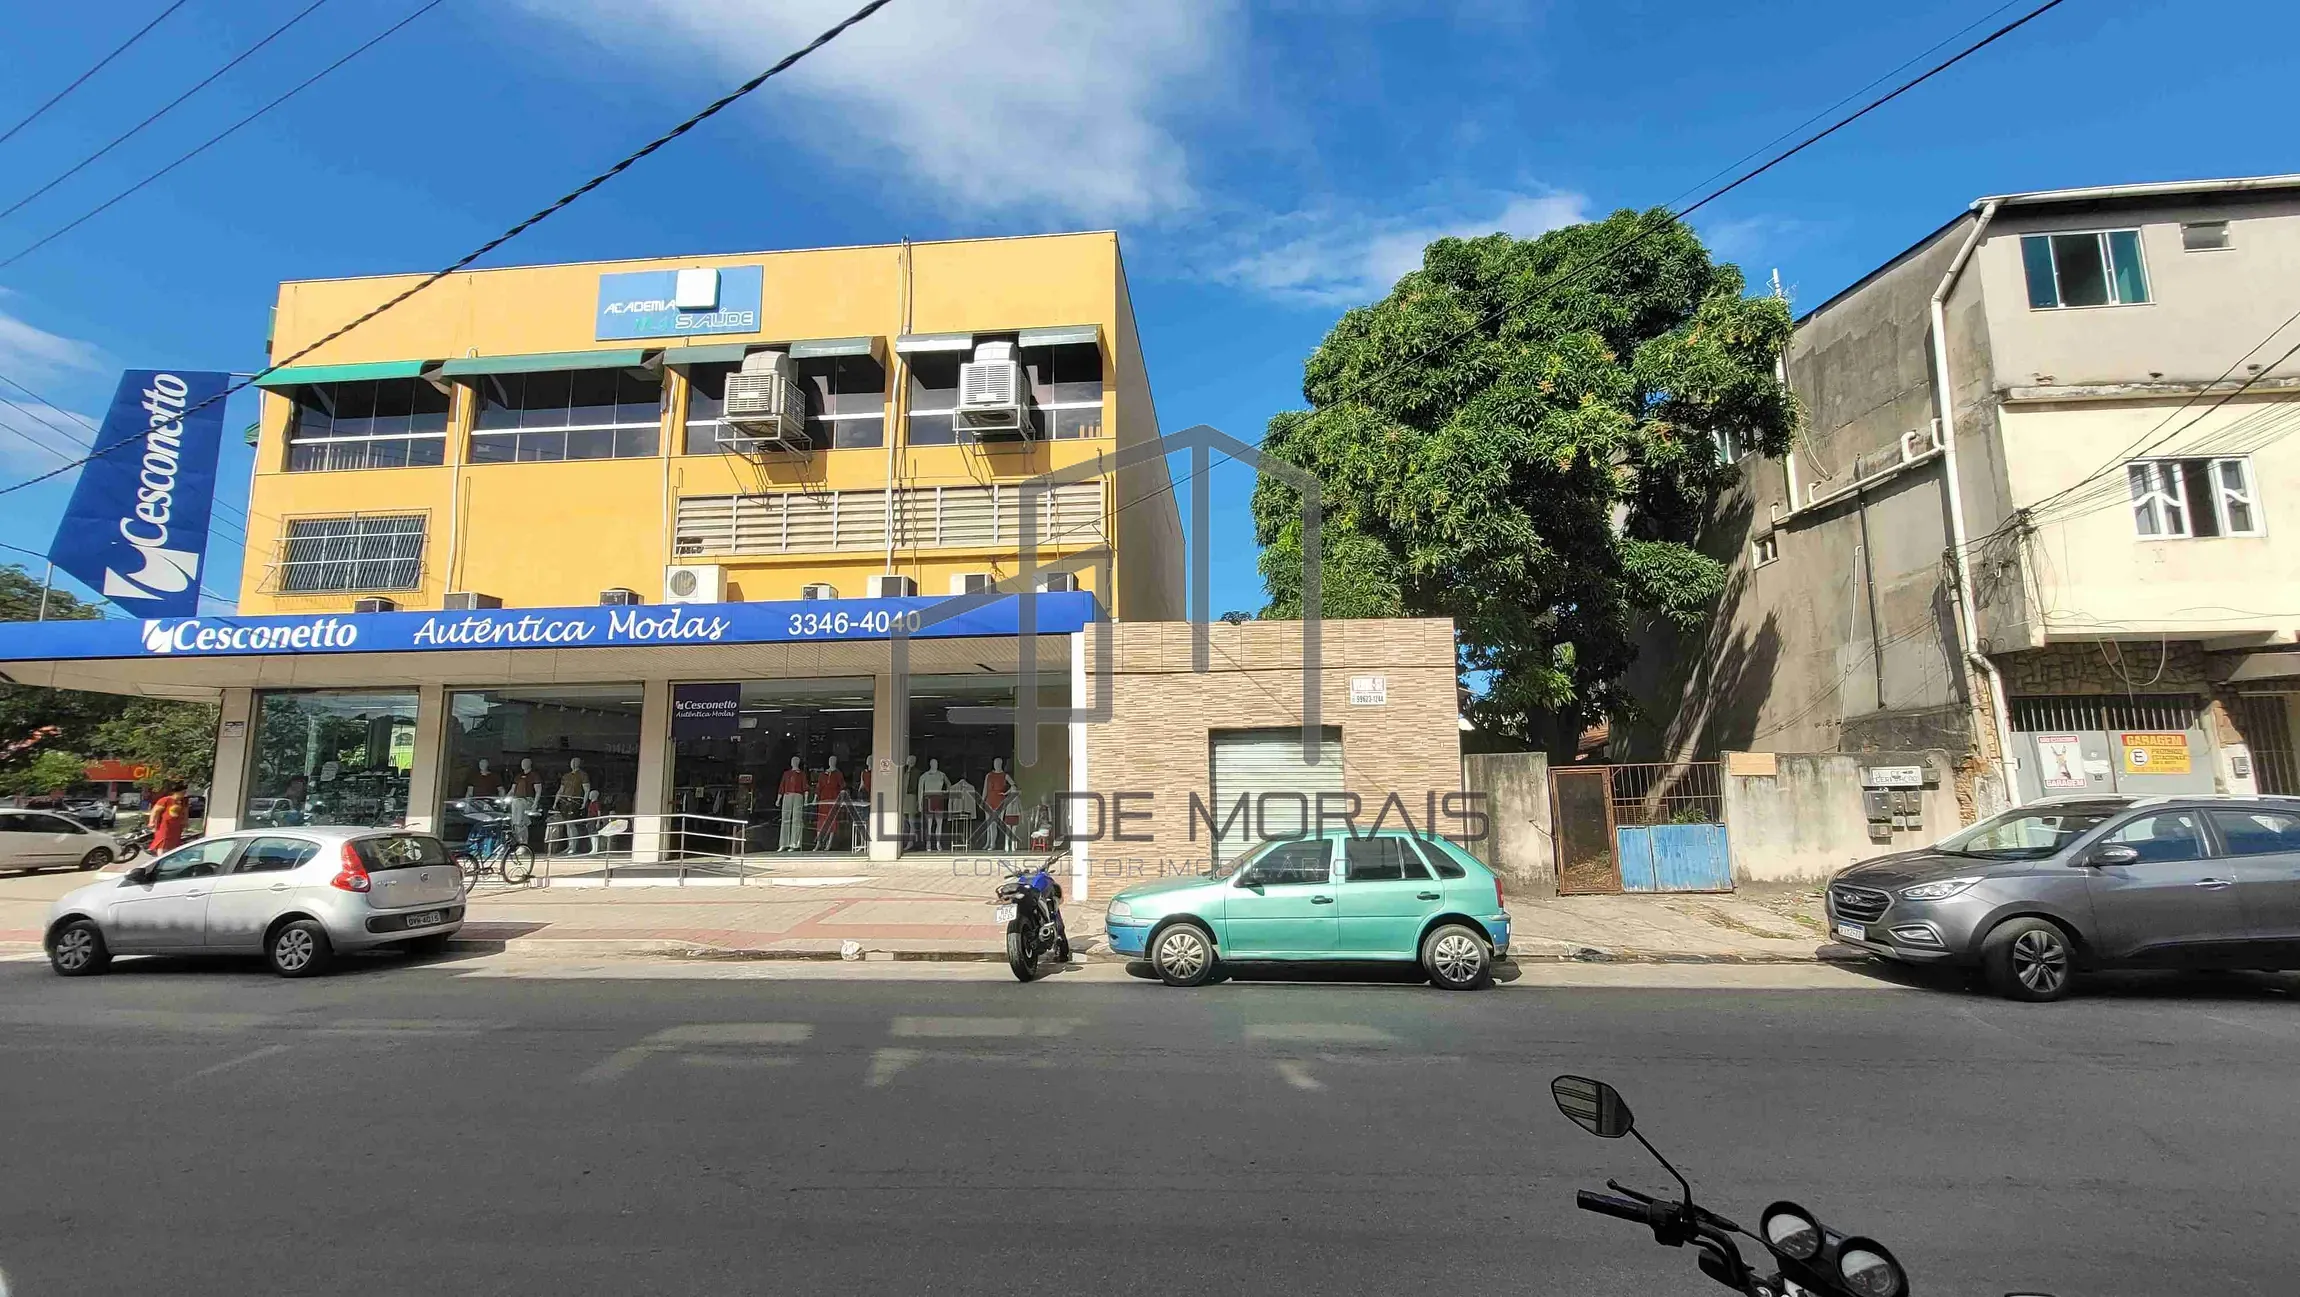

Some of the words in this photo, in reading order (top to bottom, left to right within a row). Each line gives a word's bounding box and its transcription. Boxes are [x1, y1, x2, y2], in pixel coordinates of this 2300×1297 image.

[604, 299, 676, 314] ACADEMIA
[675, 307, 754, 329] SAÚDE
[119, 373, 189, 548] Cesconetto
[174, 618, 358, 650] Cesconetto
[413, 614, 596, 645] Autêntica
[607, 608, 731, 641] Modas
[788, 610, 921, 635] 3346-4040
[2126, 735, 2183, 746] GARAGEM
[2046, 779, 2084, 787] GARAGEM
